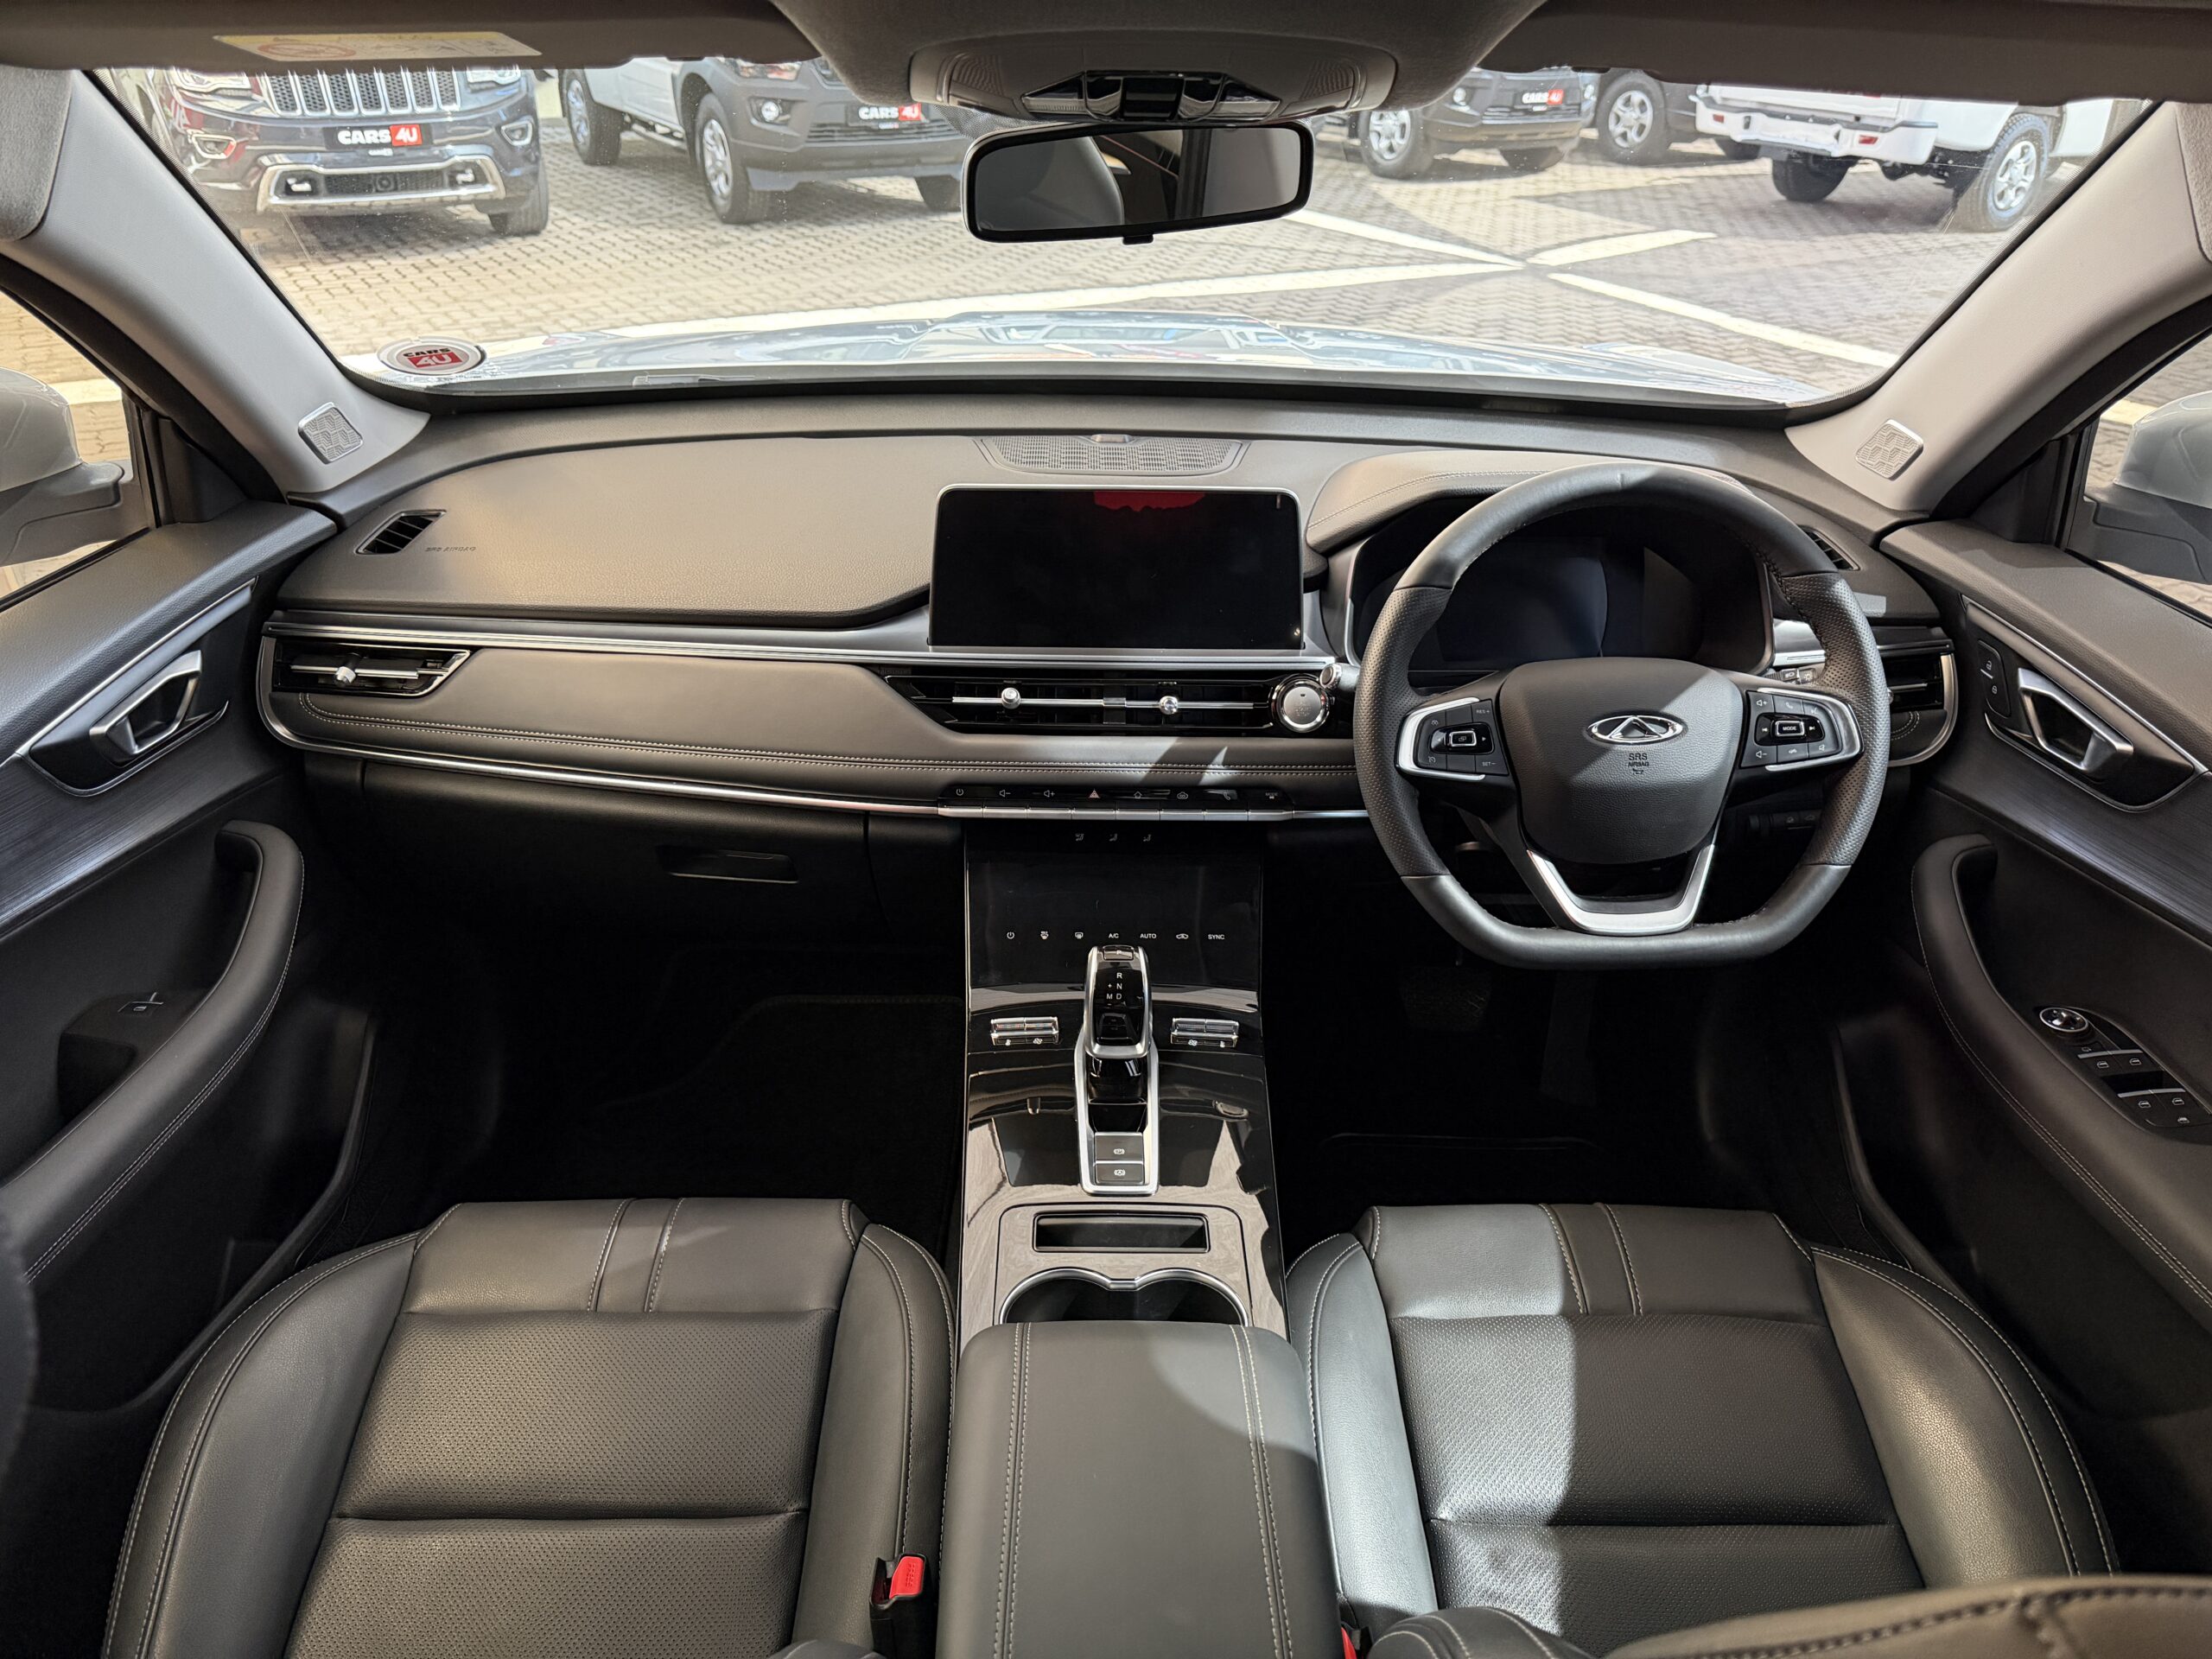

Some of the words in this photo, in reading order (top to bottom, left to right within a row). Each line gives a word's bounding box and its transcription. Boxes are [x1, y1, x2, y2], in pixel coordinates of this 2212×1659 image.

[859, 107, 899, 119] CARS
[338, 130, 391, 144] CARS
[395, 127, 418, 143] 4U
[403, 347, 451, 357] CARS
[416, 353, 453, 365] 4U
